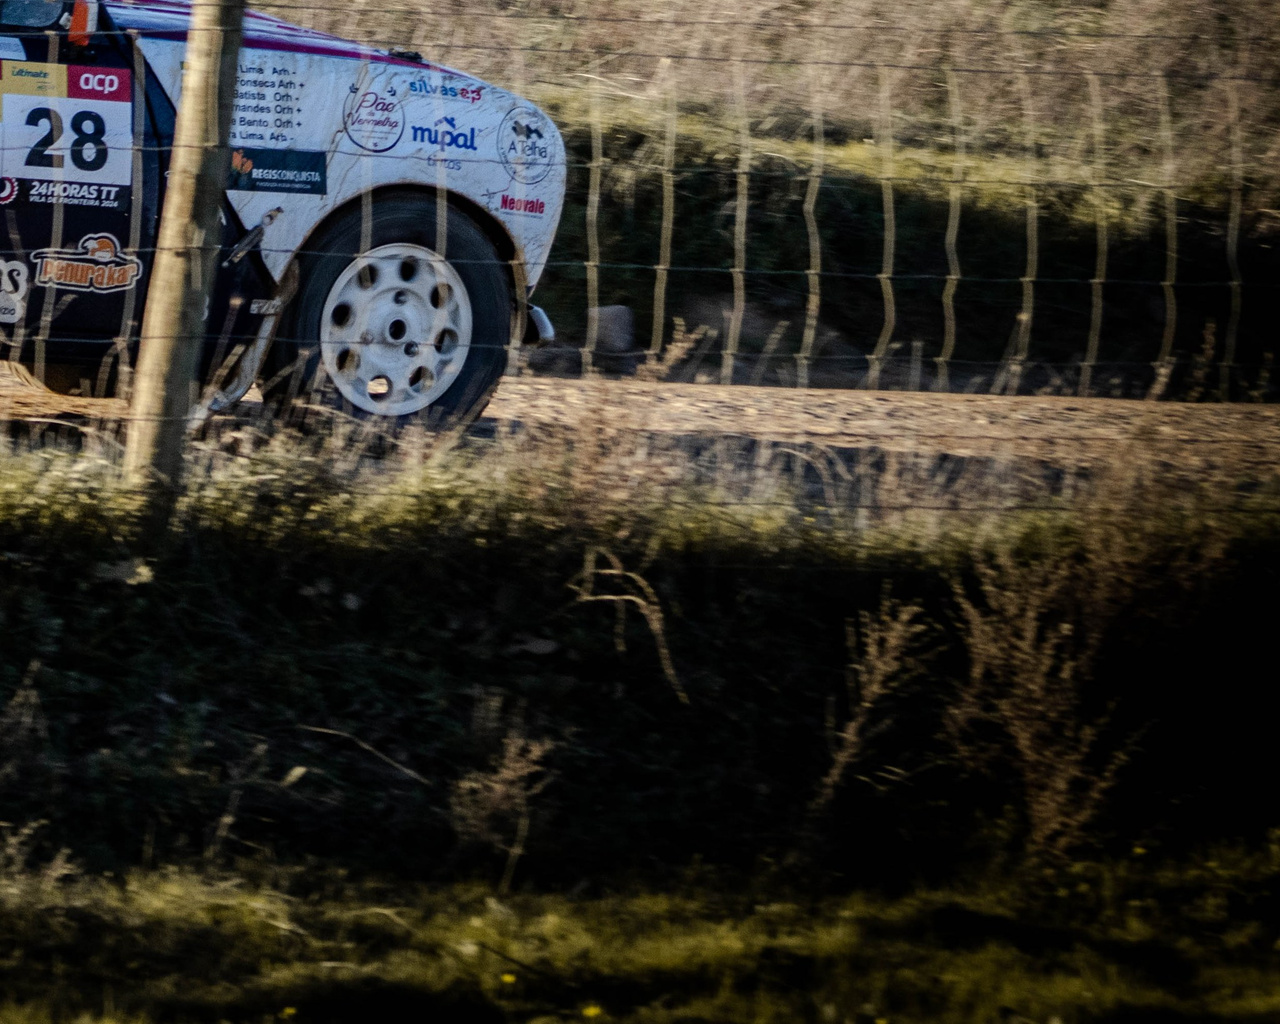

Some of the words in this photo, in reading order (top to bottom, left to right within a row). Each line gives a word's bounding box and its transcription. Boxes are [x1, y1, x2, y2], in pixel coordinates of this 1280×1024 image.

[240, 65, 264, 75] Lima
[79, 73, 119, 94] acp
[235, 77, 276, 89] Fonseca
[410, 79, 458, 98] silvas
[355, 91, 396, 114] Pão
[238, 116, 269, 127] Bento
[24, 106, 108, 172] 28
[239, 131, 264, 141] Lima
[411, 126, 478, 152] mipal
[251, 168, 322, 182] REGISCONQUISTA
[29, 181, 98, 199] 24HORAS
[100, 186, 120, 200] TT
[29, 195, 46, 203] VILA
[59, 197, 99, 207] FRONTEIRA
[501, 194, 546, 214] Neovale
